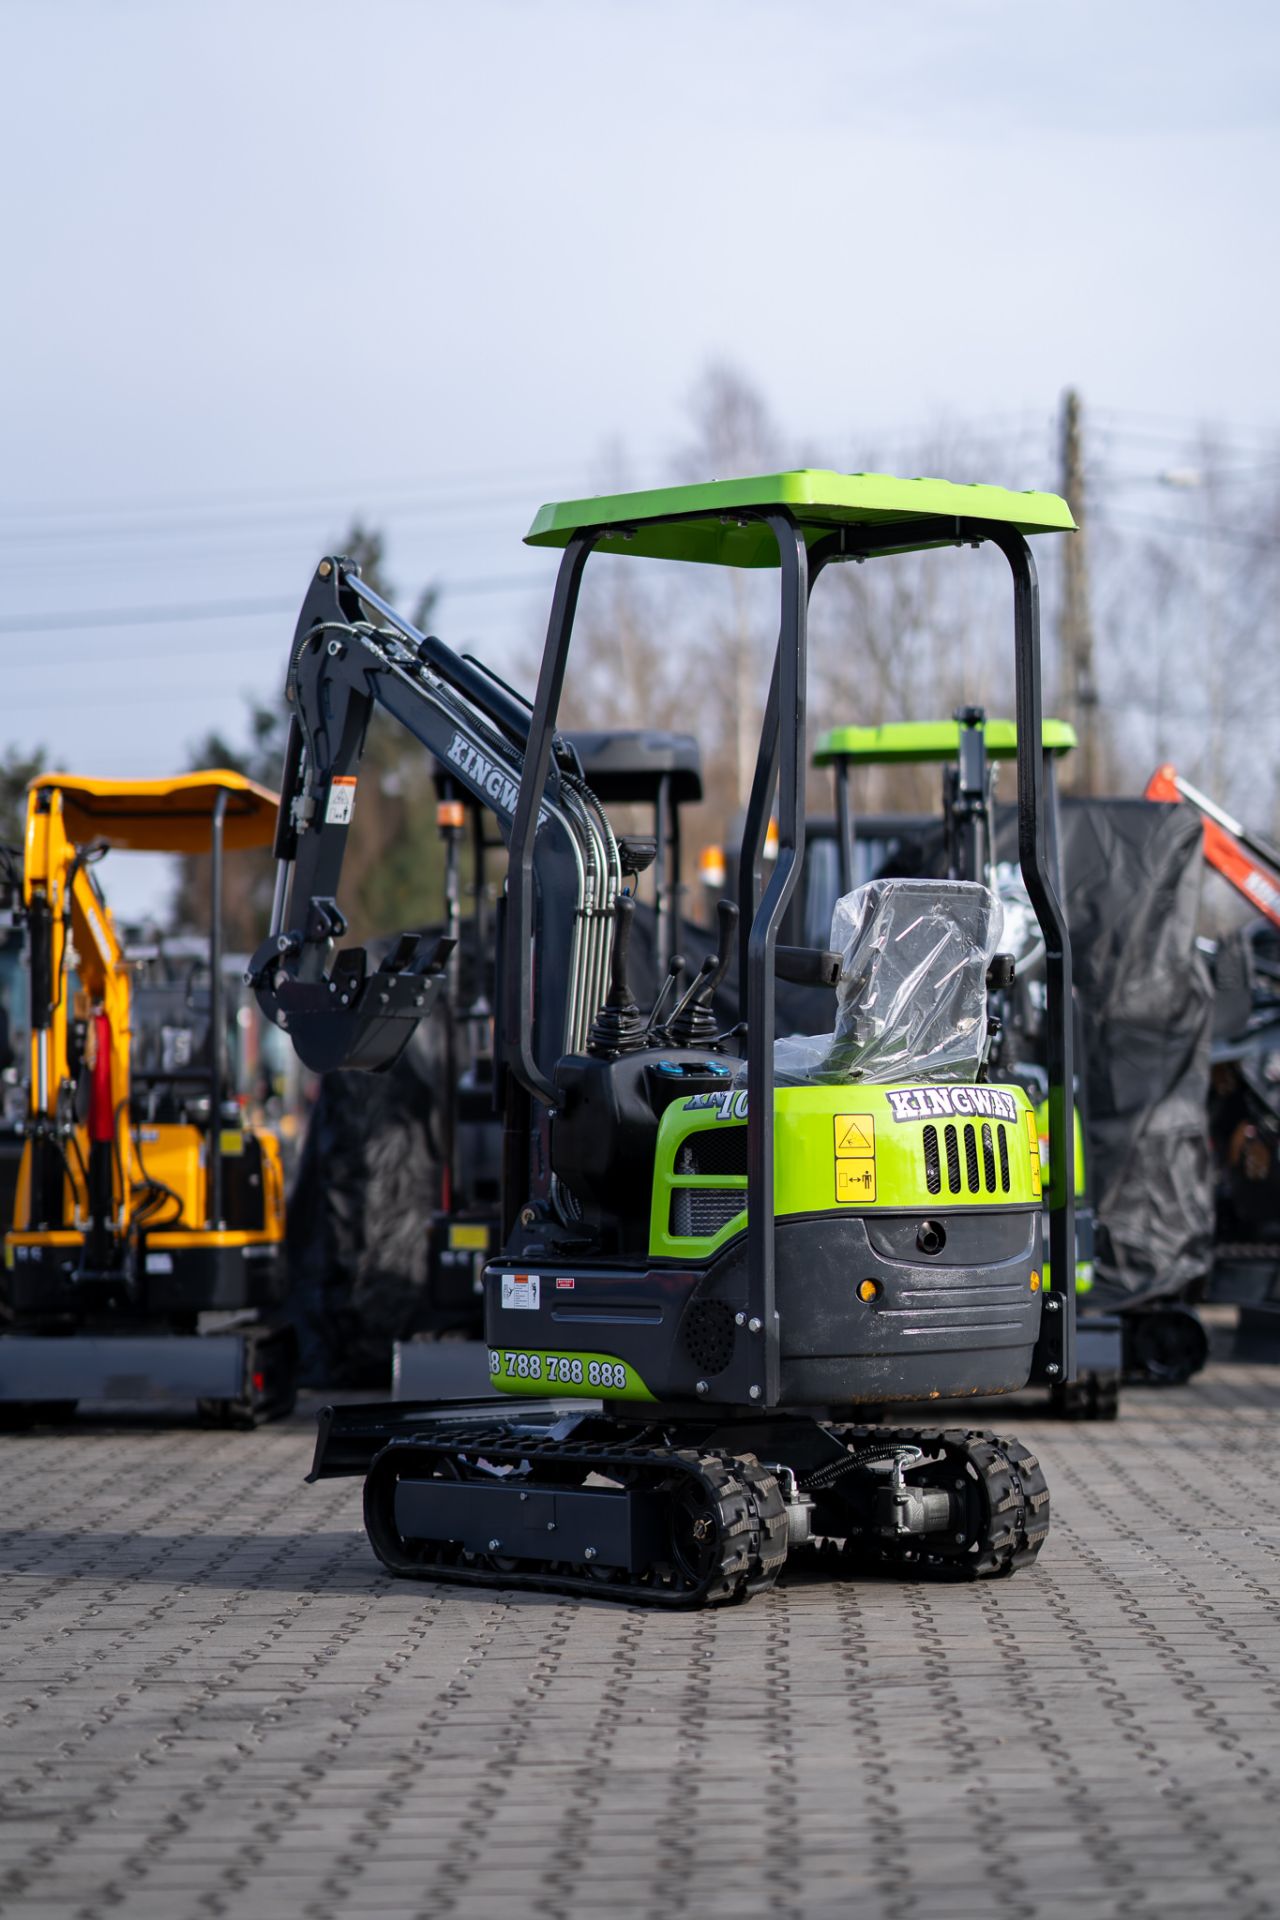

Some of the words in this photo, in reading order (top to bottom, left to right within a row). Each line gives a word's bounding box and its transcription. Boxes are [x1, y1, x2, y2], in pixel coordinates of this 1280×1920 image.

[446, 733, 548, 835] KINGWY
[887, 1086, 1016, 1122] KINGWAY
[504, 1352, 541, 1379] 788
[546, 1357, 583, 1384] 788
[588, 1361, 626, 1389] 888
